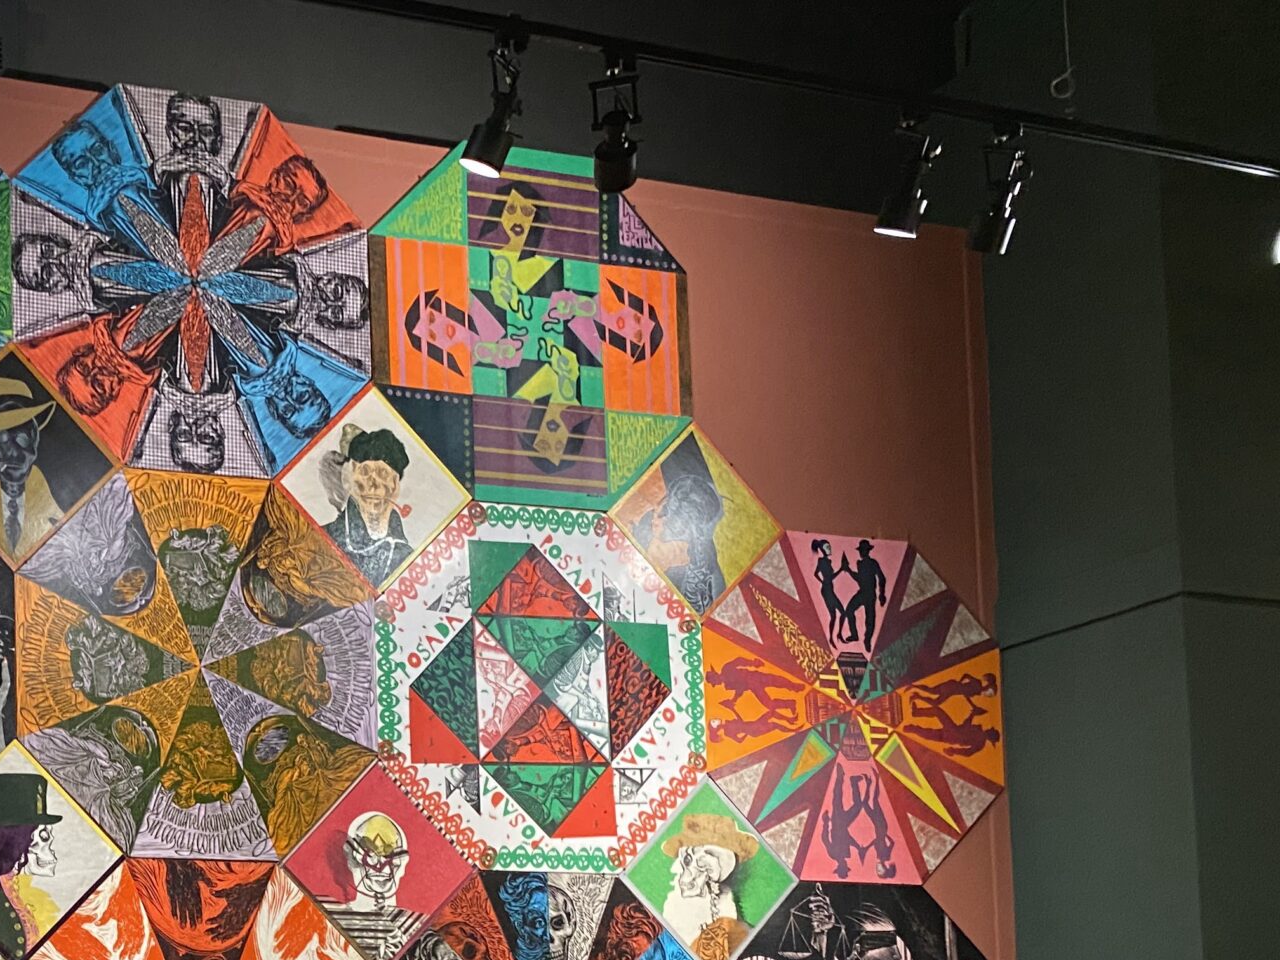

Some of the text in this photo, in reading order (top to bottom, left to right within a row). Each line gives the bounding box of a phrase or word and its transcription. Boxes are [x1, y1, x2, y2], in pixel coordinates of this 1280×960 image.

[540, 534, 605, 610] POSADA
[397, 614, 465, 679] POSADA
[622, 698, 685, 766] POSADA
[481, 782, 542, 849] POSADA
